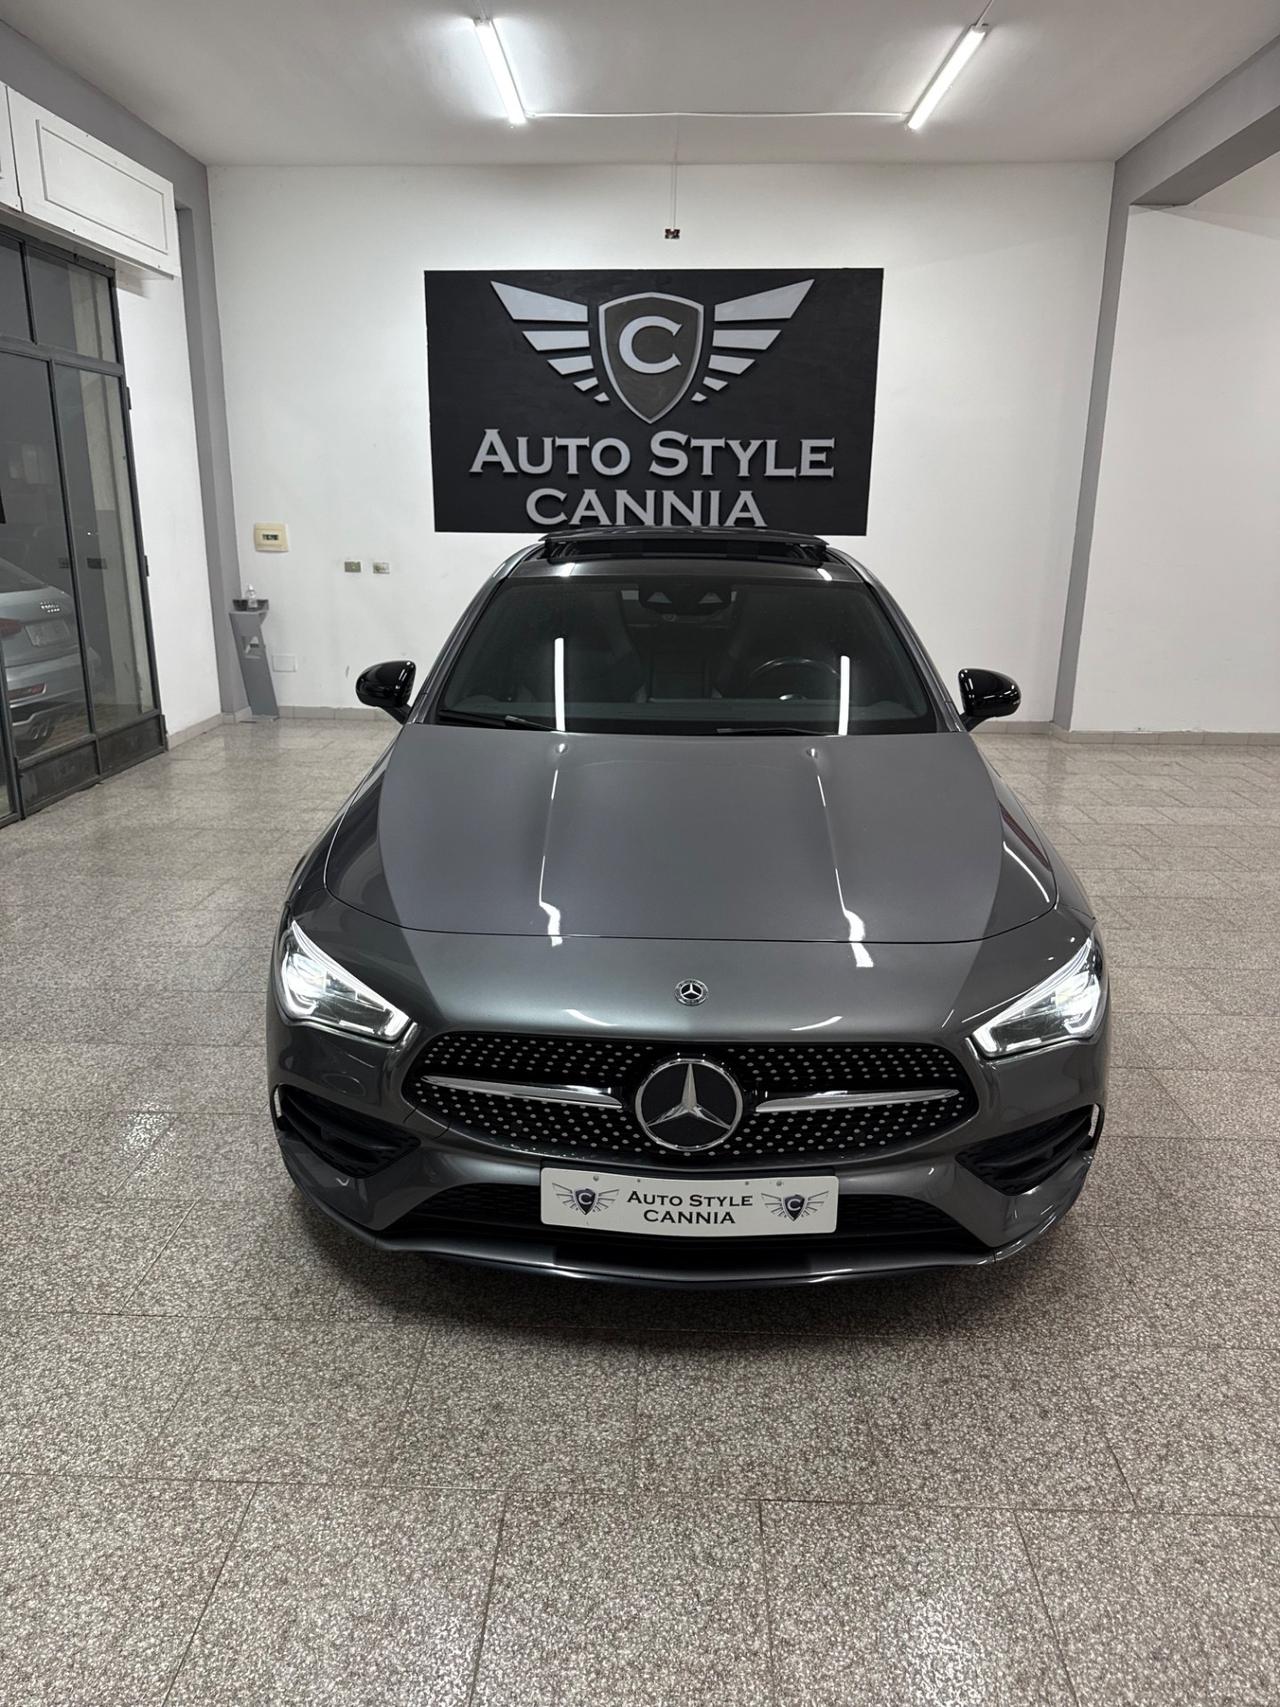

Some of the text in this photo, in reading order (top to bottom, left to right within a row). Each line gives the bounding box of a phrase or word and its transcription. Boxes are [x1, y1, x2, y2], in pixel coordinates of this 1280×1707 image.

[618, 315, 683, 375] C
[469, 429, 835, 478] AUTO STYLE
[525, 488, 768, 528] CANNIA
[578, 1192, 593, 1205] C
[626, 1190, 754, 1207] AUTO STYLE
[787, 1198, 802, 1211] C
[643, 1209, 736, 1224] CANNIA
